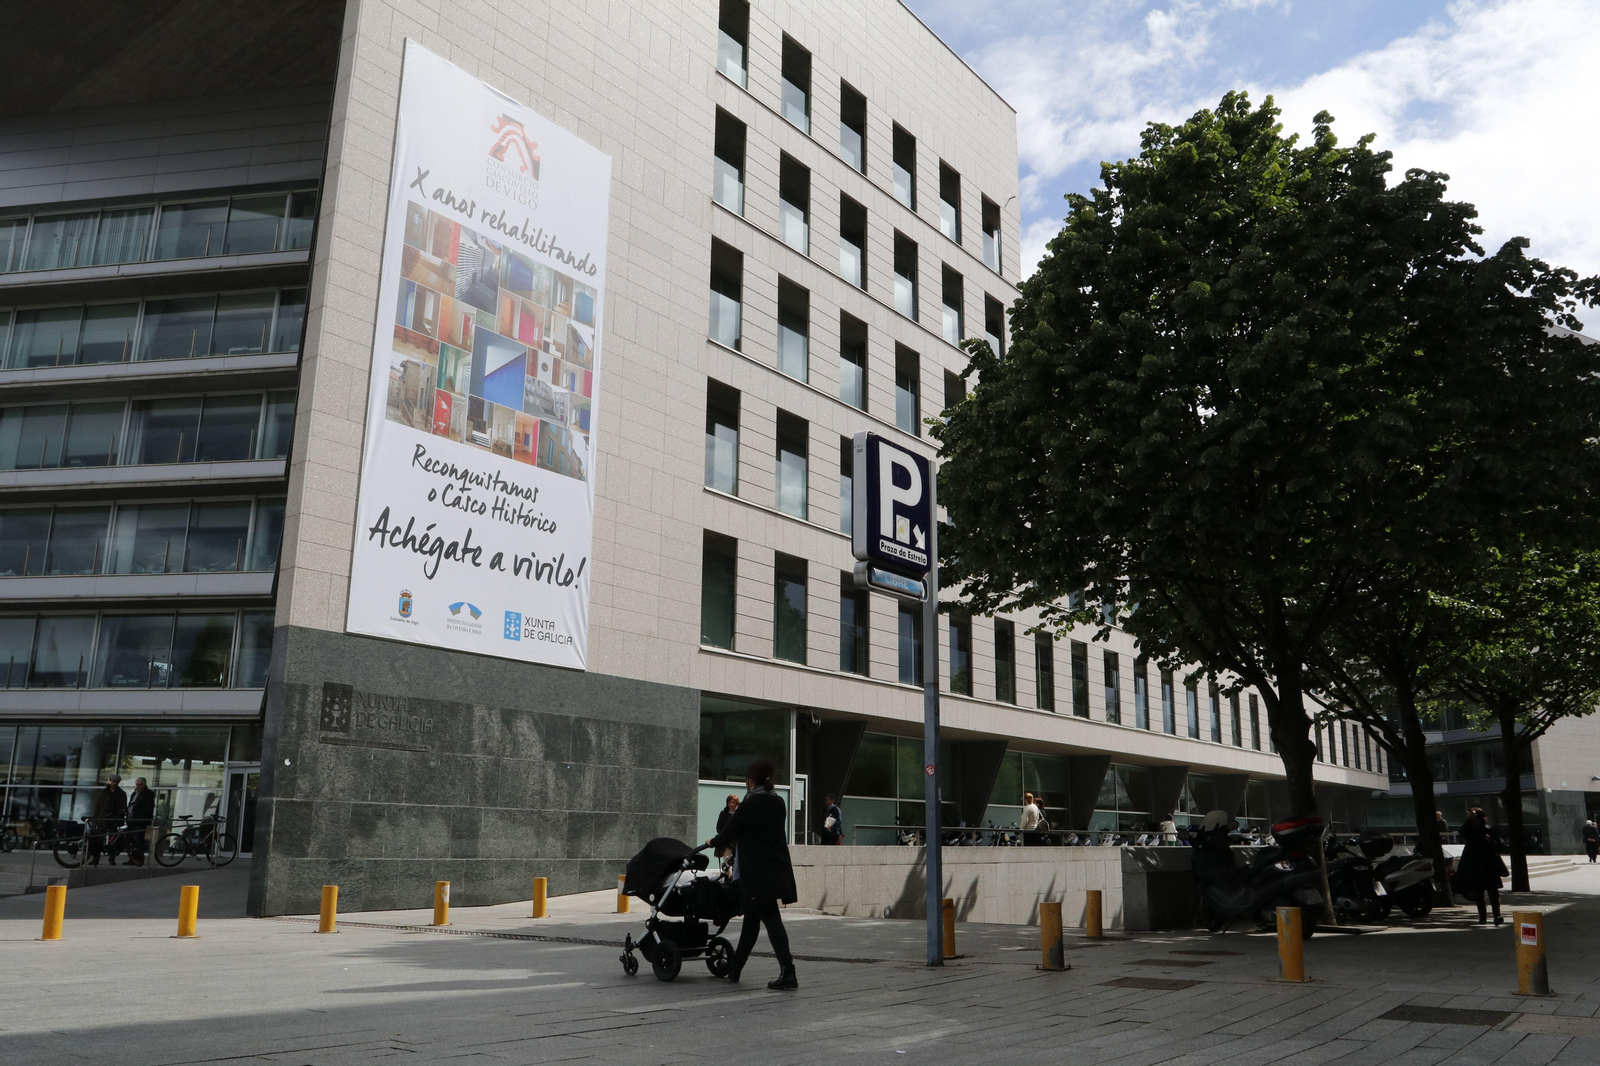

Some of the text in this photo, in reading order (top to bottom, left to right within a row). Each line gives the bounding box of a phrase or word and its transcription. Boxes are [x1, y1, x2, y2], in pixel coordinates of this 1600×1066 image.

[487, 158, 538, 190] CONSORCIO
[486, 176, 537, 210] DE VIGO
[410, 166, 430, 199] X
[481, 209, 598, 277] rehabilitando
[412, 444, 539, 503] Reconquistamos
[878, 441, 923, 539] P
[427, 483, 557, 534] o Casco Histórico
[369, 506, 587, 589] Achégate a vivilo!
[880, 540, 927, 565] Praza da Estrela
[885, 574, 909, 590] LIBRE
[524, 628, 573, 647] DE GALICIA
[525, 616, 555, 632] XUNTA
[354, 691, 407, 713] XUNTA
[355, 711, 433, 734] DE GALICIA
